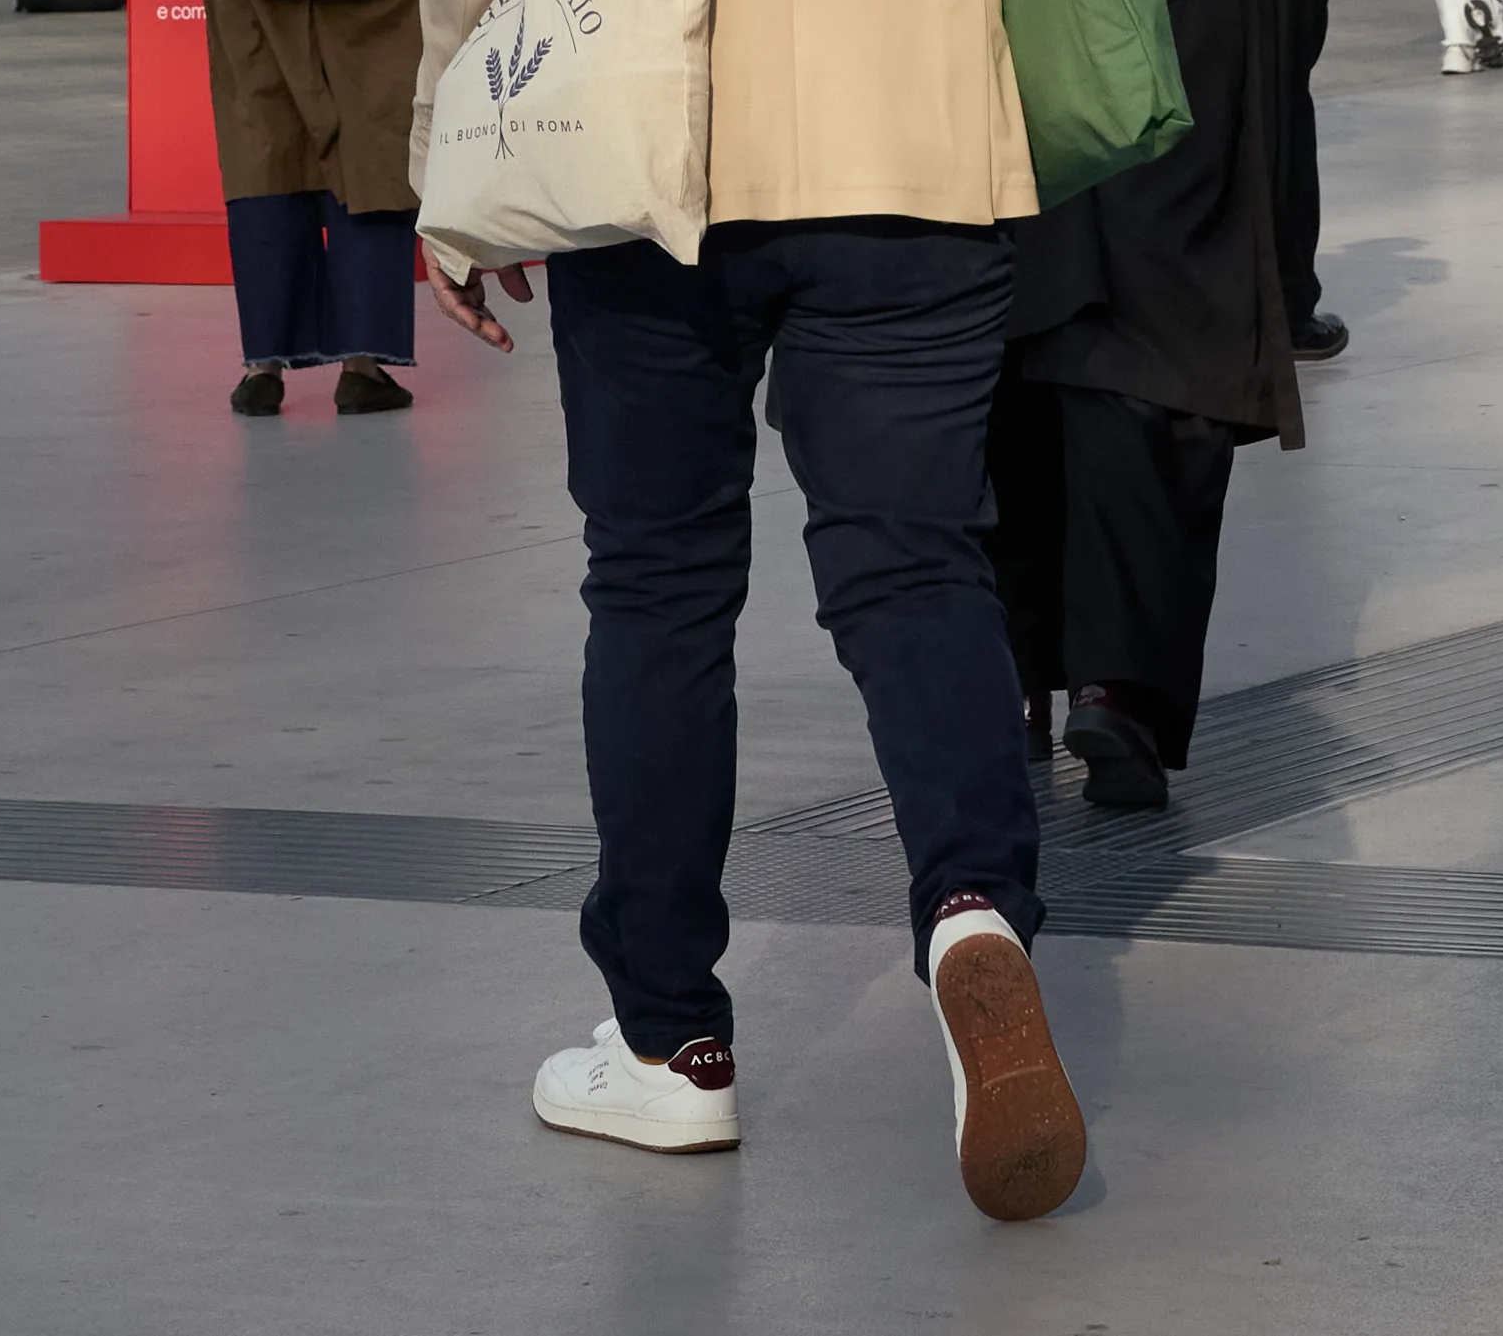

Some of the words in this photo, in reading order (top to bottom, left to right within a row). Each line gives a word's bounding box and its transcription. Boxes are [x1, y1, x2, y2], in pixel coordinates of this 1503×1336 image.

[439, 131, 449, 145] IL
[457, 123, 496, 141] BUONO
[510, 121, 525, 132] DI
[537, 120, 583, 132] ROMA
